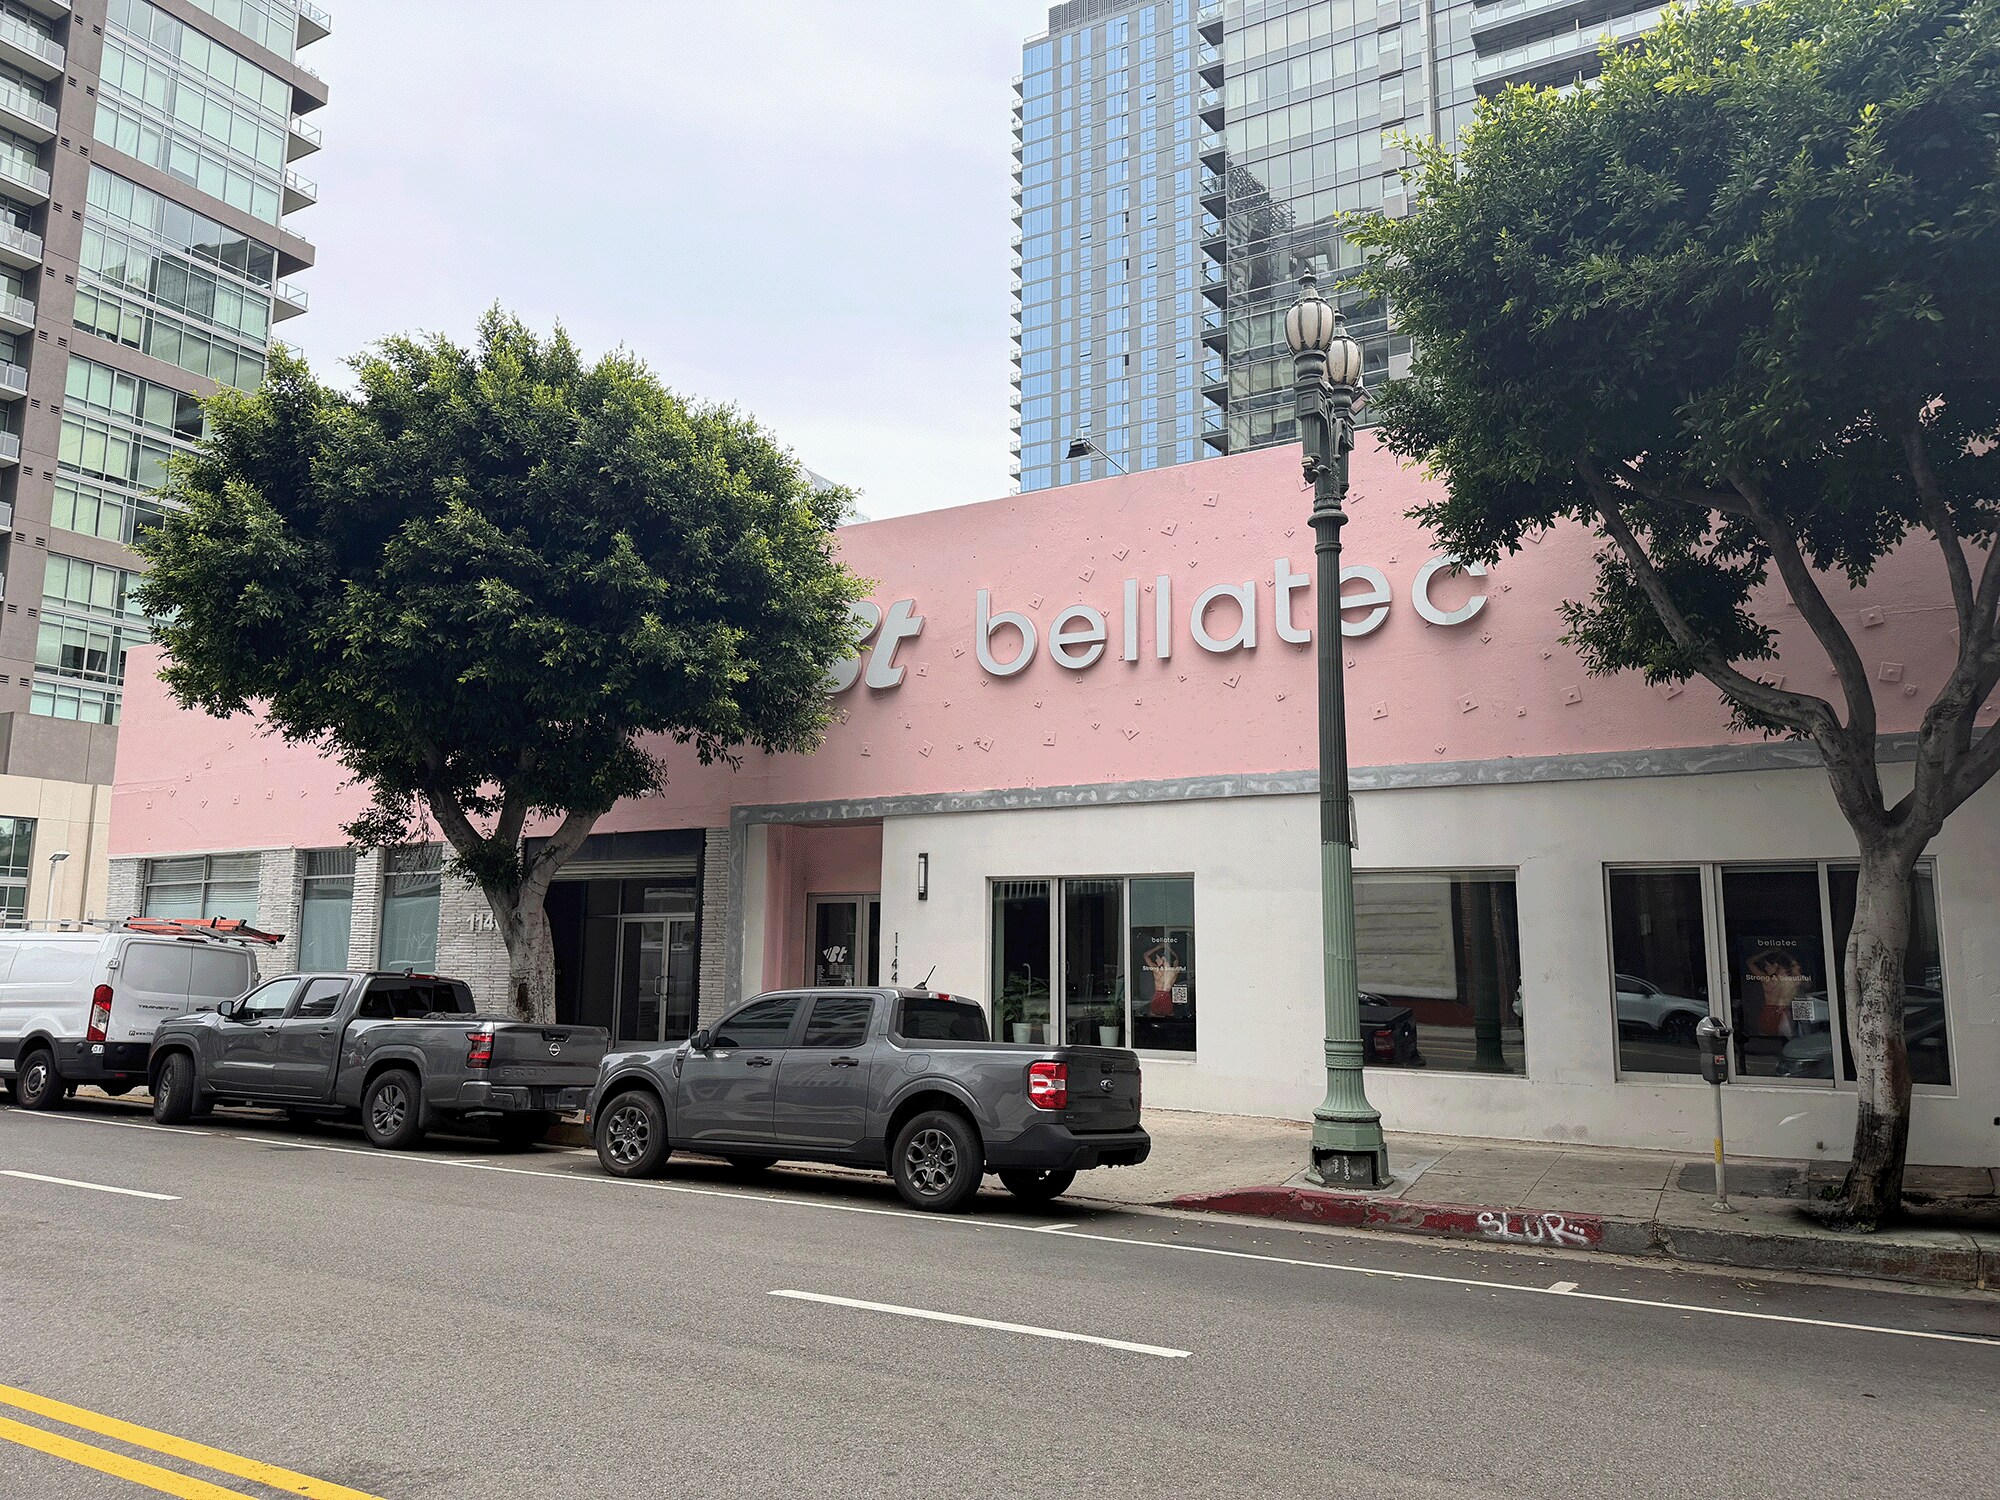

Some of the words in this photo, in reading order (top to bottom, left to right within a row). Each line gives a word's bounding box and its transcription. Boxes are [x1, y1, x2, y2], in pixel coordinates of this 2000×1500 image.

[975, 555, 1489, 677] bellatec
[890, 931, 899, 984] 1144
[1757, 939, 1798, 947] bellatec
[1745, 974, 1770, 982] Strong
[1780, 974, 1812, 982] beautiful
